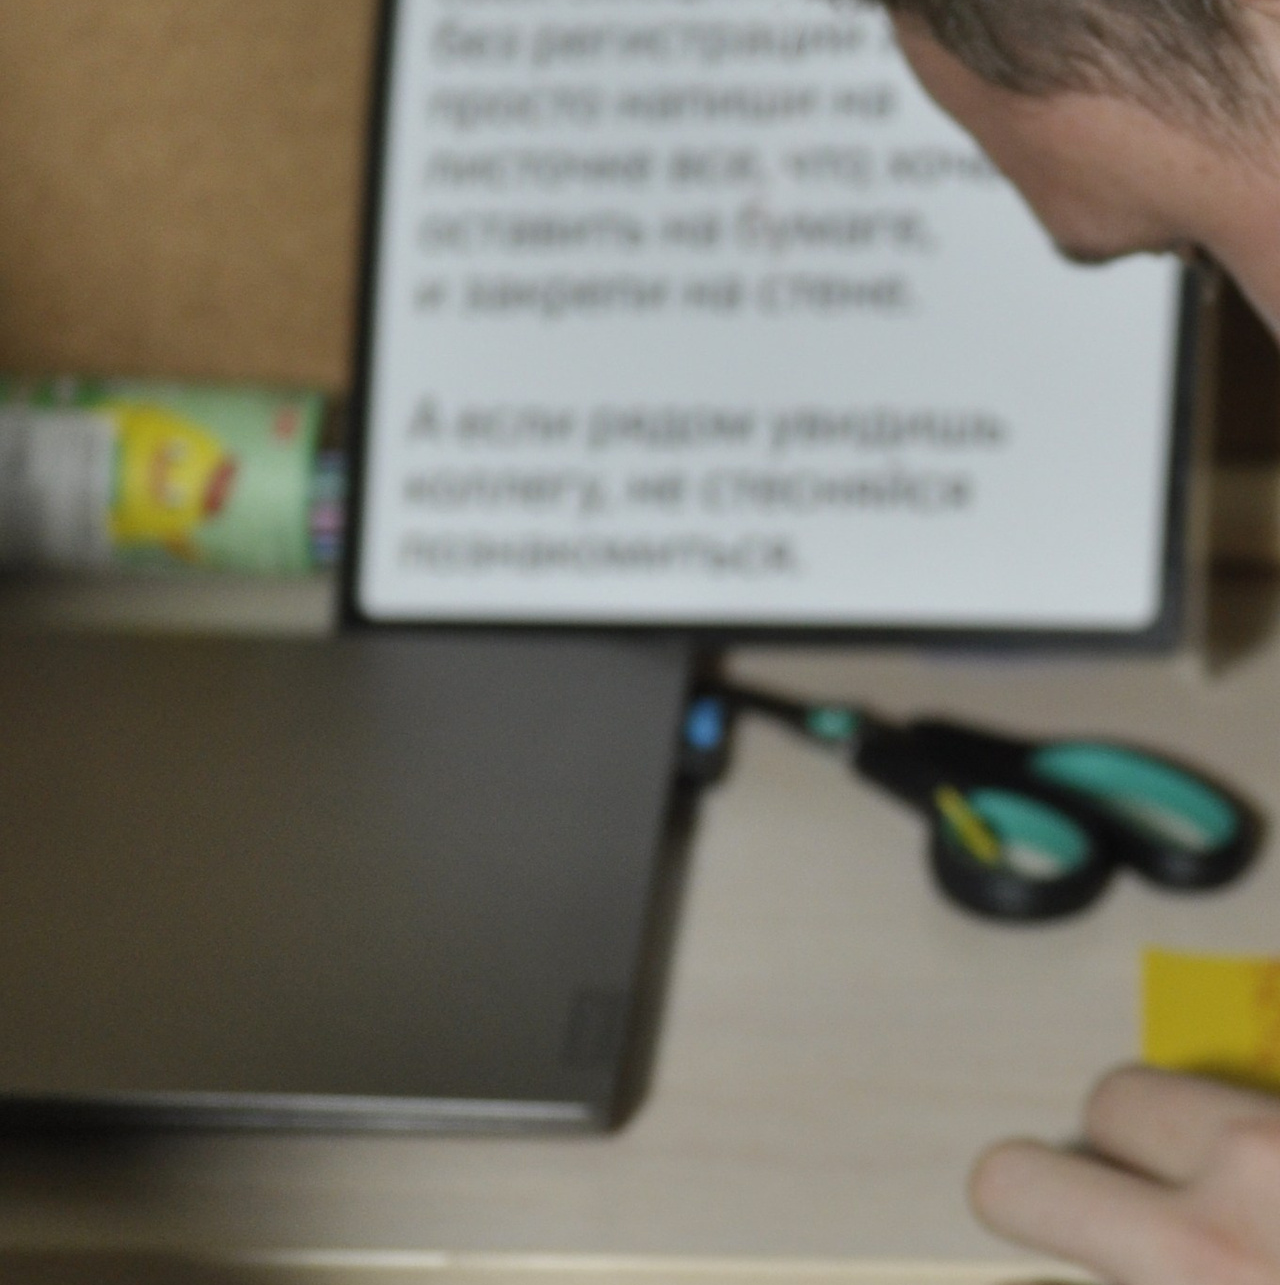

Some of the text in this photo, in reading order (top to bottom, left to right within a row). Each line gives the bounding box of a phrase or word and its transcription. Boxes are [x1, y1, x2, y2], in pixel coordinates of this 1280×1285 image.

[434, 17, 868, 69] без регистрации
[427, 83, 898, 138] просто напиши на
[426, 149, 656, 188] листочке
[783, 148, 874, 188] что
[419, 199, 938, 258] оставить на бумаге,
[415, 272, 919, 321] и закрепи на стене.
[409, 396, 1010, 456] А если рядом увидишь
[626, 473, 689, 509] не
[700, 465, 974, 513] стесняйся
[399, 535, 804, 579] познакомиться.
